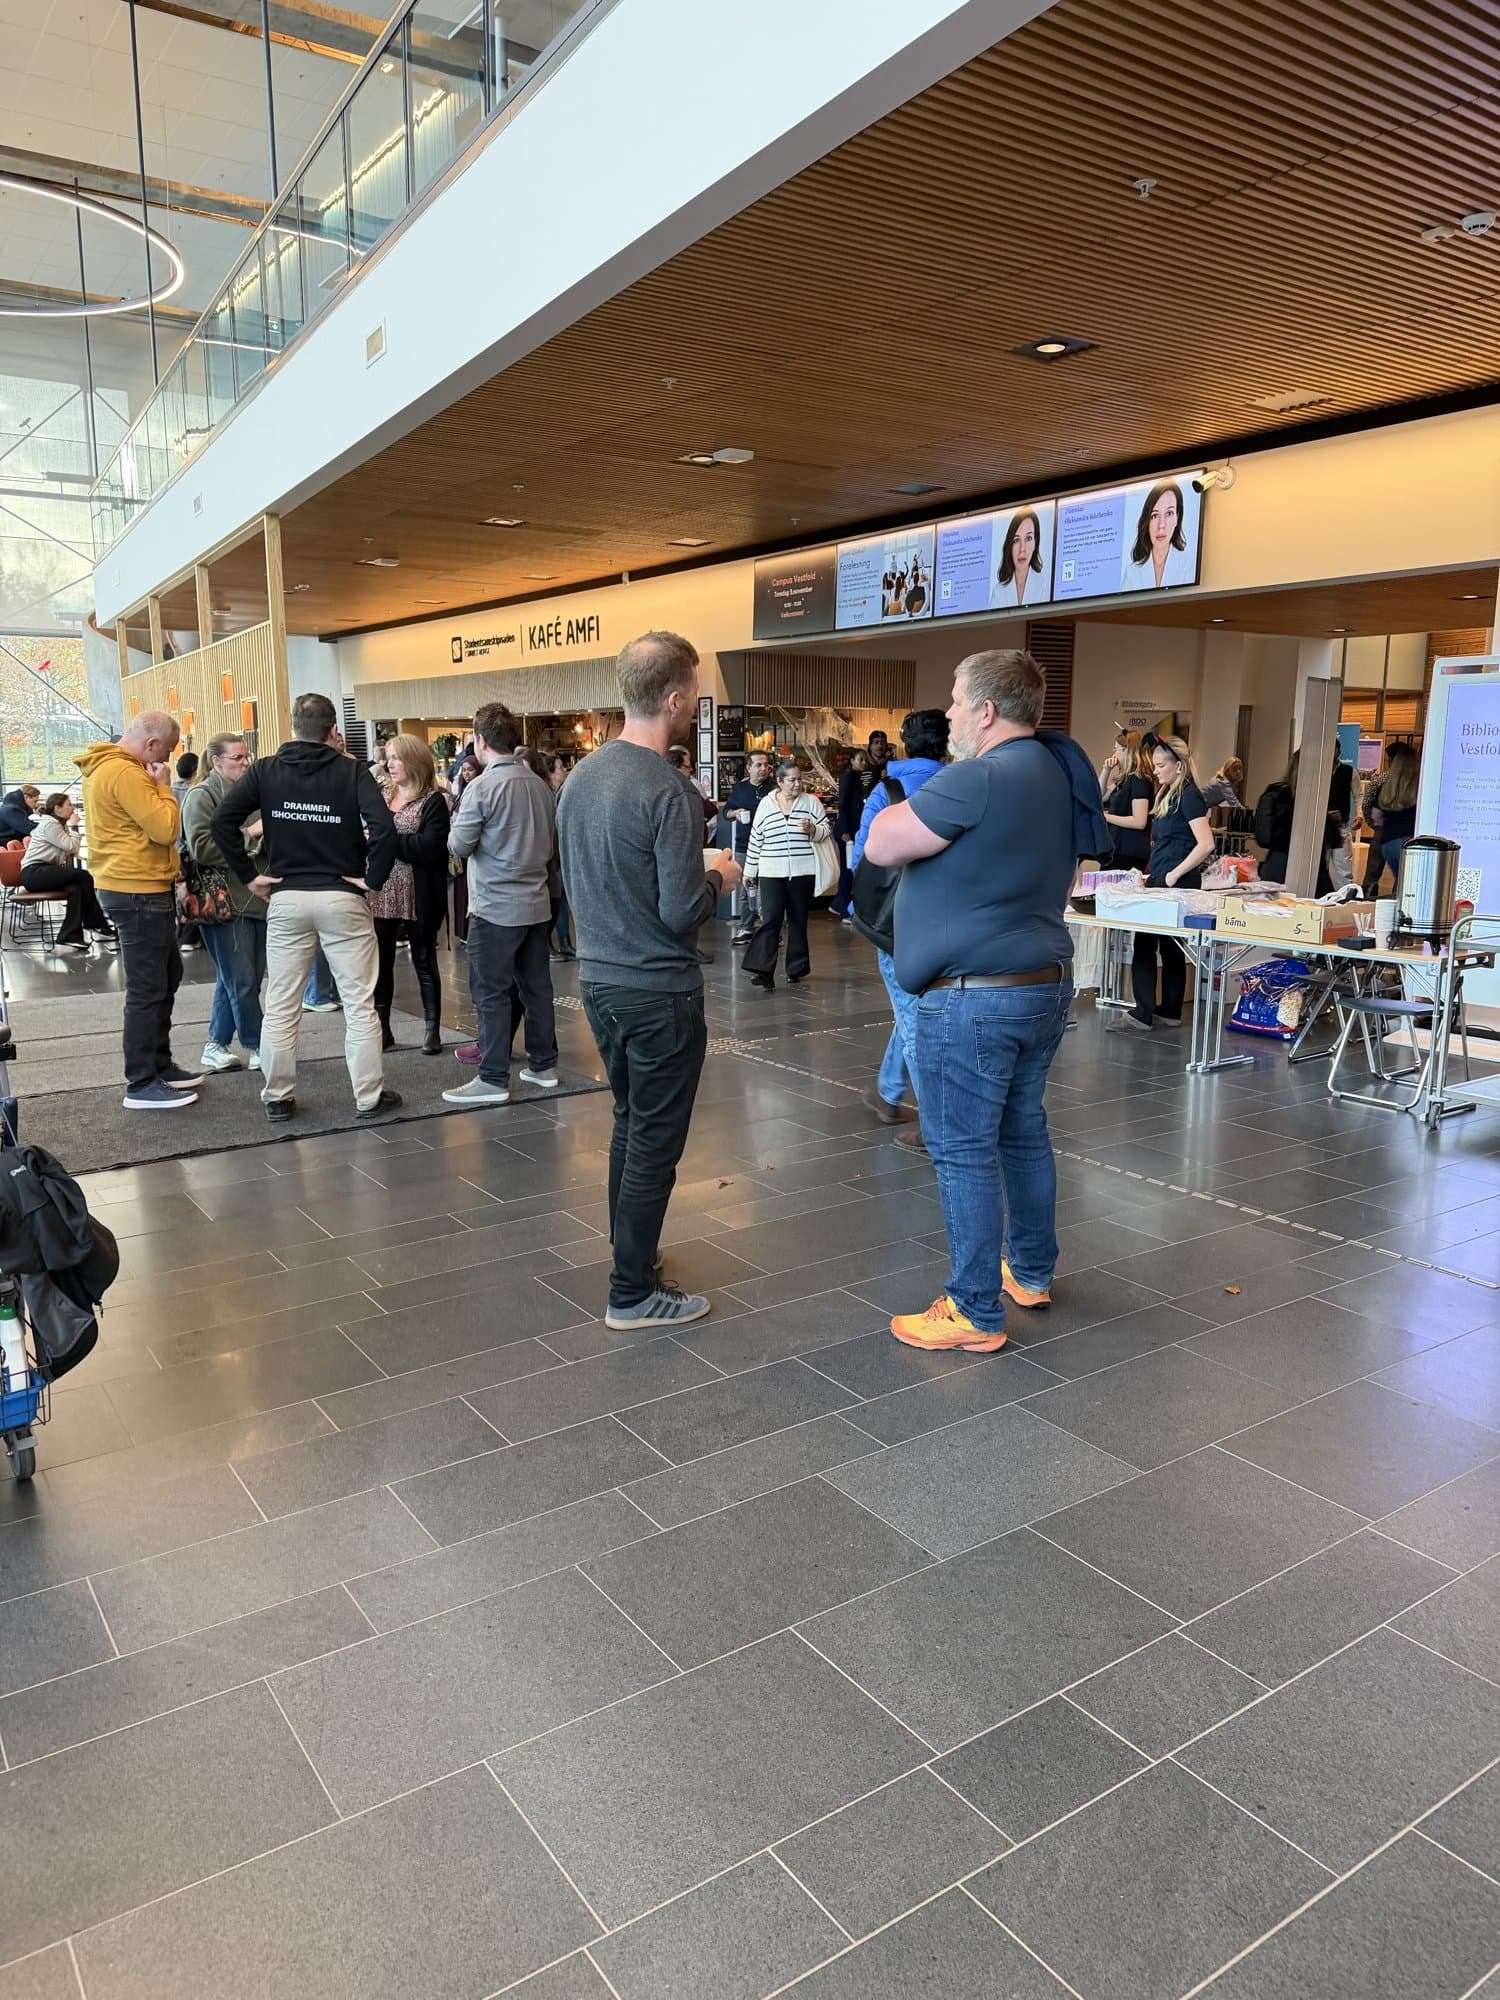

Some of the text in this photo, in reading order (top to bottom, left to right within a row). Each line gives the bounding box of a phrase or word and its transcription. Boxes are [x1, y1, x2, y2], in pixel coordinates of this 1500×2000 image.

[771, 571, 816, 587] Campus Vestfold
[528, 615, 600, 651] KAFÉ AMFI
[283, 801, 330, 813] DRAMMEN
[271, 810, 342, 824] ISHOCKEYKLUBB
